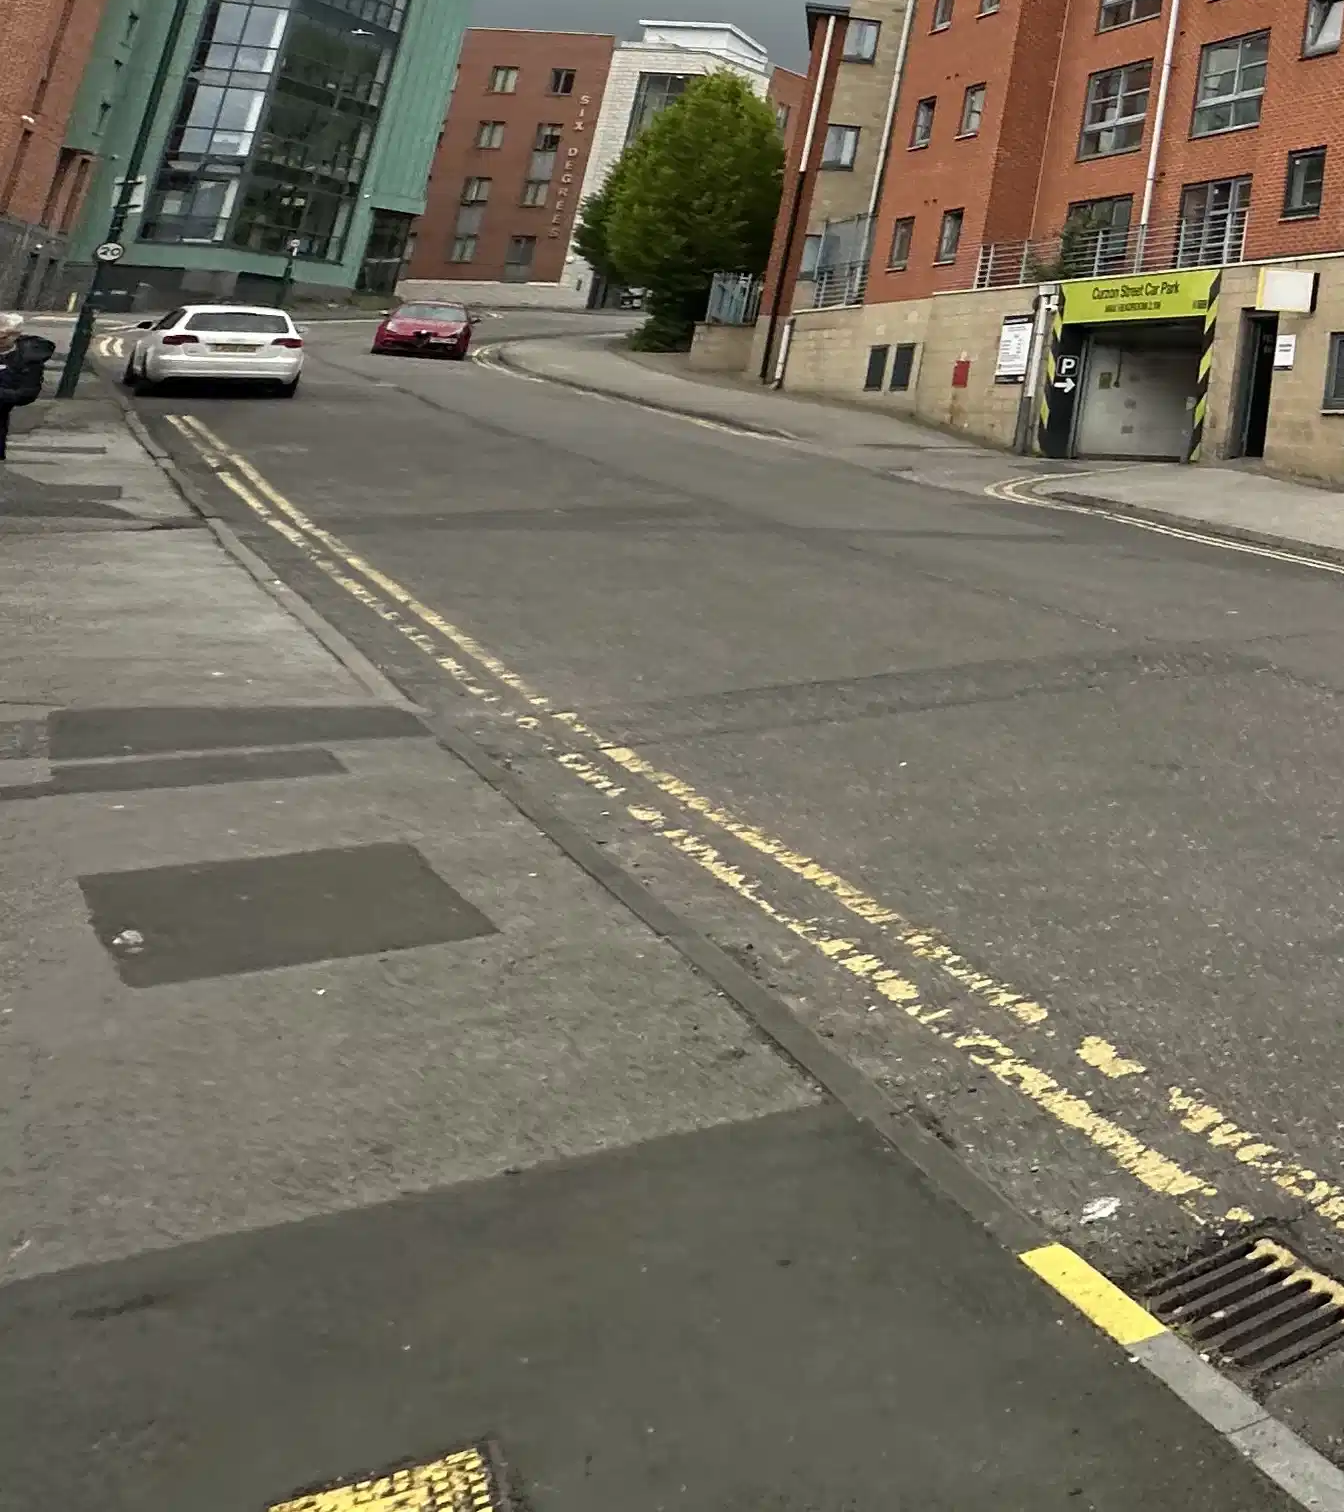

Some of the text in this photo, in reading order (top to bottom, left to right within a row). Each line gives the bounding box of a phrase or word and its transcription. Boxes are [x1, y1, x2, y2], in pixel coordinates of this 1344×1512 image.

[549, 94, 591, 239] SIX DEGREES
[100, 247, 121, 256] 20
[1120, 284, 1144, 299] Street
[1145, 282, 1160, 296] Car
[1160, 280, 1180, 295] Park
[1061, 358, 1076, 374] P
